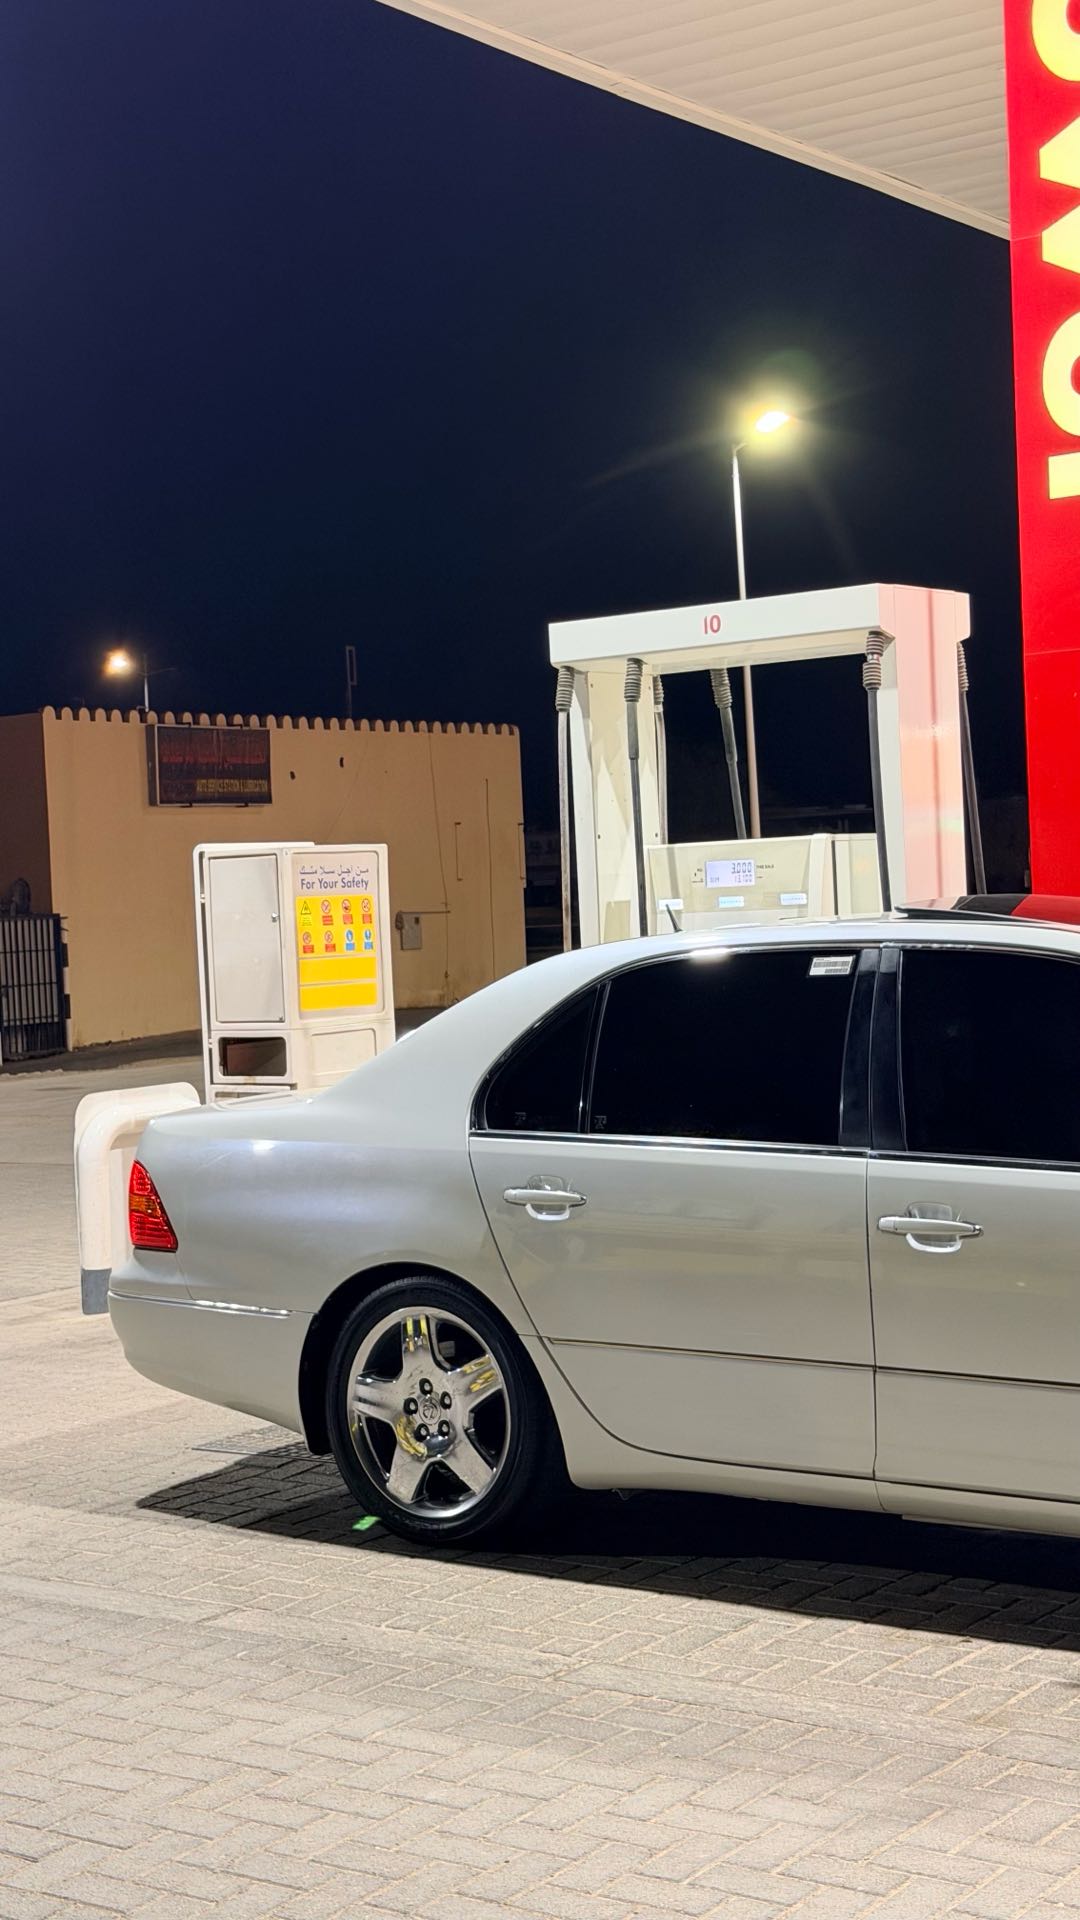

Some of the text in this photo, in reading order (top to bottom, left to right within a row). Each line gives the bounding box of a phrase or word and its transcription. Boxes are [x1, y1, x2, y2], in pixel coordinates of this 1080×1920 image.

[703, 614, 722, 635] 10
[355, 866, 369, 876] من
[300, 876, 369, 890] For Your Safety
